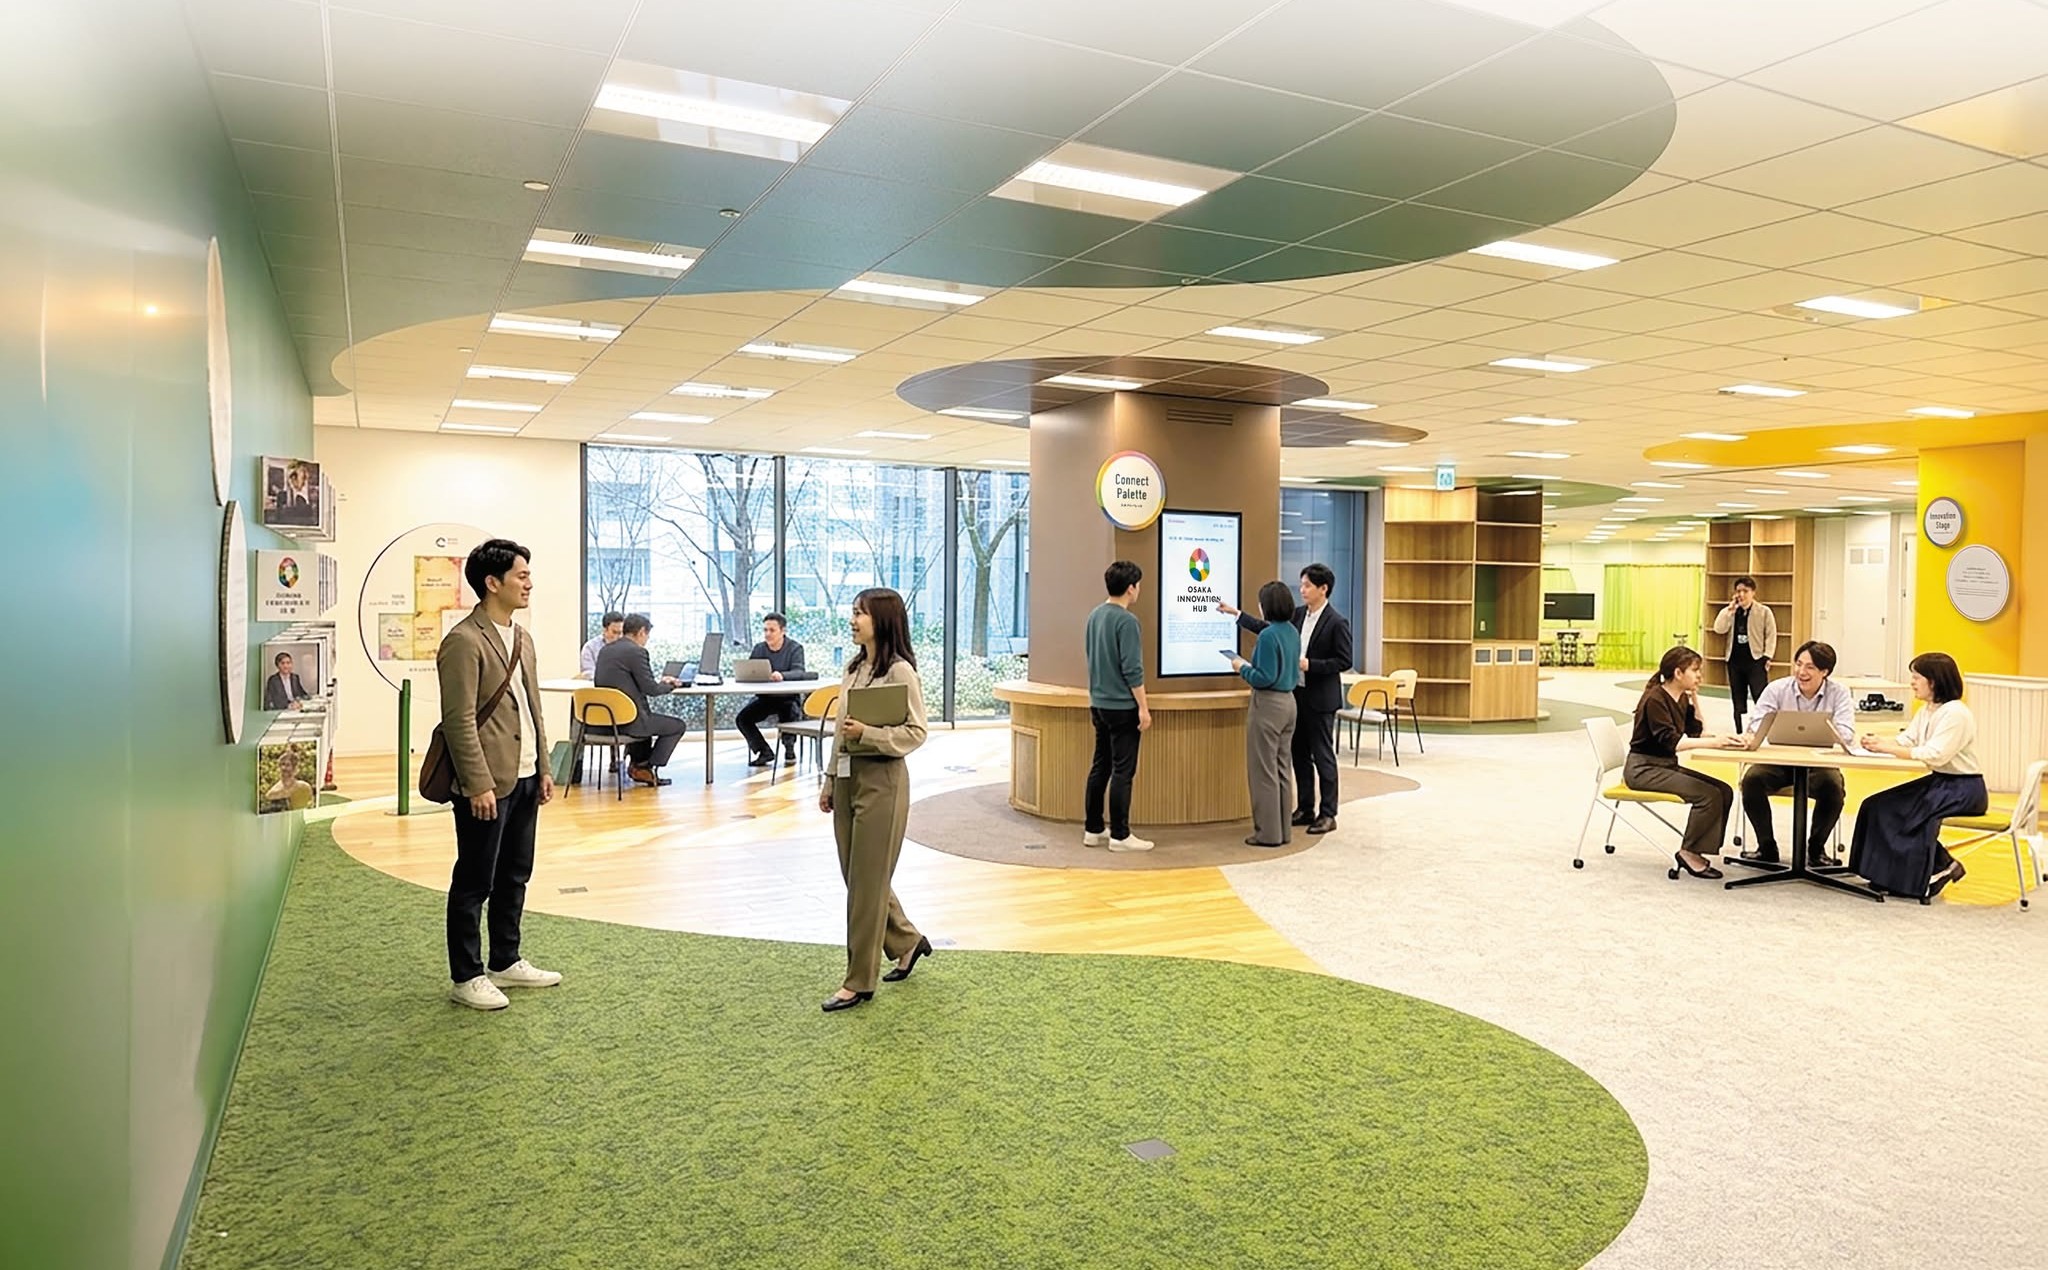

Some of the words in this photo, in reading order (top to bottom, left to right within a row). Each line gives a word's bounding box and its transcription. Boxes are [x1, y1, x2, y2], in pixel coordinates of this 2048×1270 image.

[1115, 473, 1149, 486] Connect
[1117, 487, 1147, 500] Palette
[1930, 512, 1956, 520] Innovation
[1936, 521, 1950, 530] Stage
[1177, 595, 1221, 603] INNOVATION
